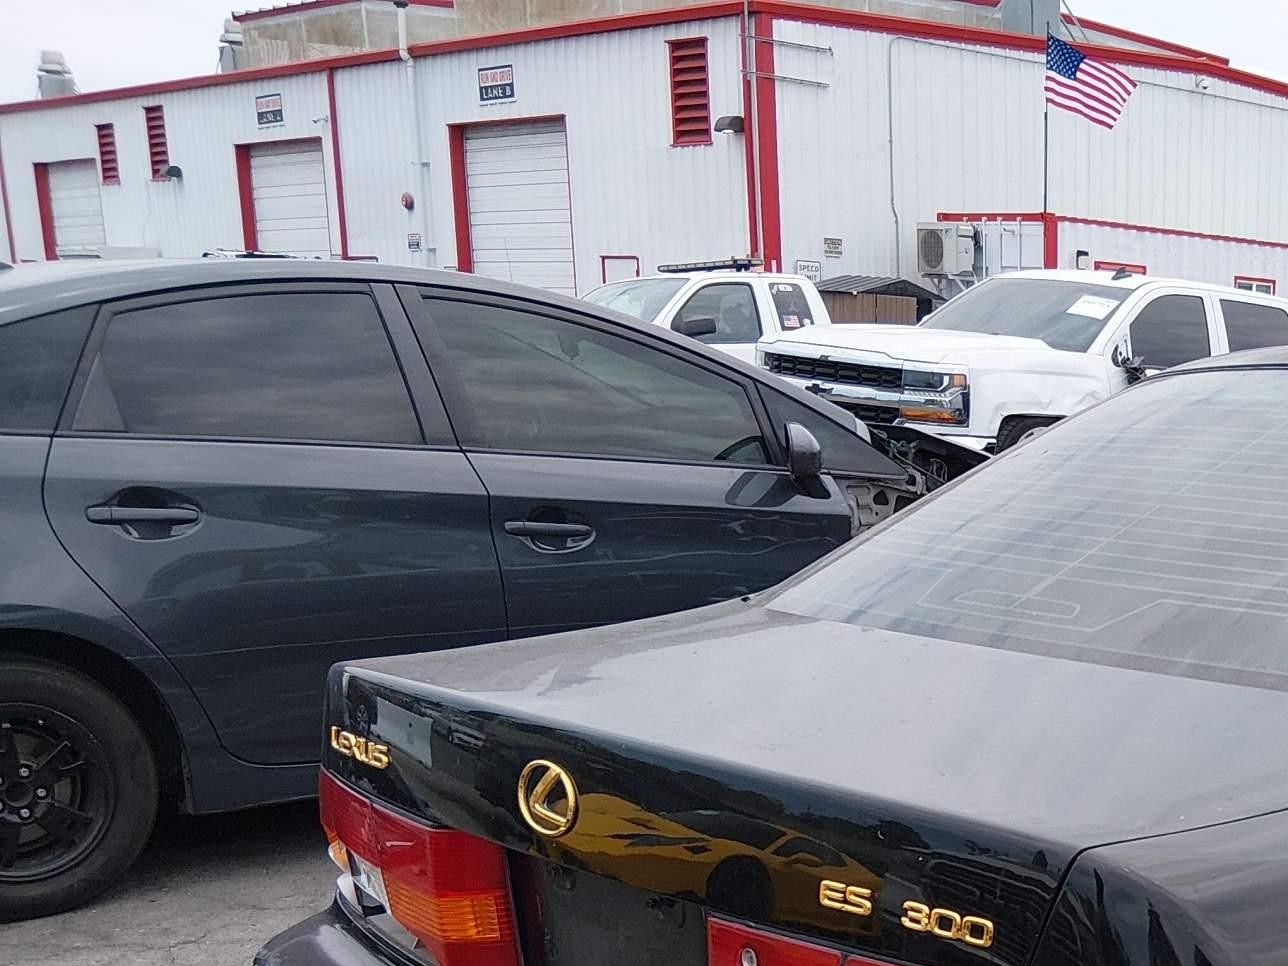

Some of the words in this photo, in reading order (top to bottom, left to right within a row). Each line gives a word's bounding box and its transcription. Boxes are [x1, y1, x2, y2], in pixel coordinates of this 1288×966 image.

[482, 87, 503, 99] LANE
[505, 85, 512, 96] B
[798, 264, 820, 272] SPEED
[331, 725, 390, 769] LEXUS
[819, 879, 873, 916] ES
[900, 900, 994, 948] 300
